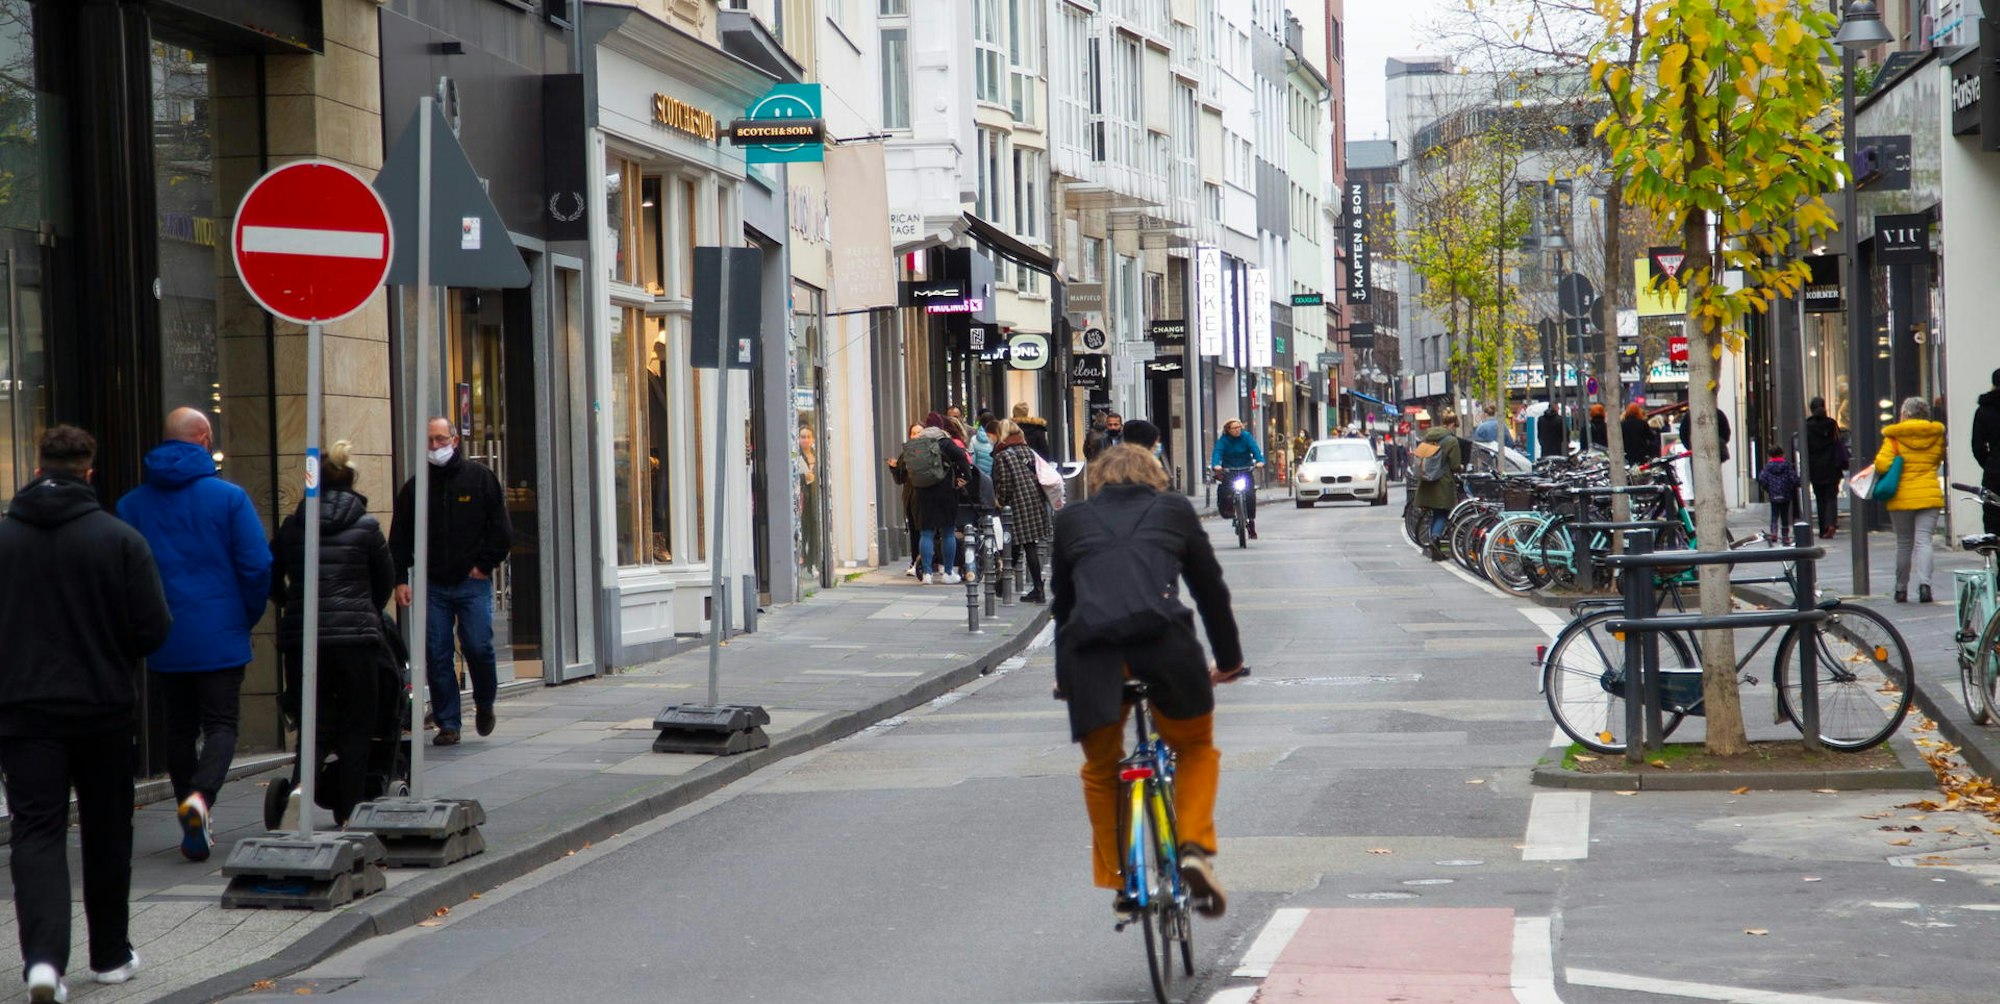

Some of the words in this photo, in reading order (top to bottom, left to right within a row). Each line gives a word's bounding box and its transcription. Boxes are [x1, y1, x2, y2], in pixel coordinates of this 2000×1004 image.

[654, 92, 716, 143] SCOTCH&SODA
[737, 126, 813, 137] SCOTCH&SODA
[1352, 184, 1362, 214] SON
[1353, 219, 1362, 229] &
[1883, 228, 1921, 243] VIU
[1354, 233, 1365, 287] KAPTEN
[1204, 252, 1217, 353] ARKET
[1806, 290, 1839, 299] KORNER
[1254, 272, 1267, 364] ARKET
[1010, 347, 1046, 357] ONLY
